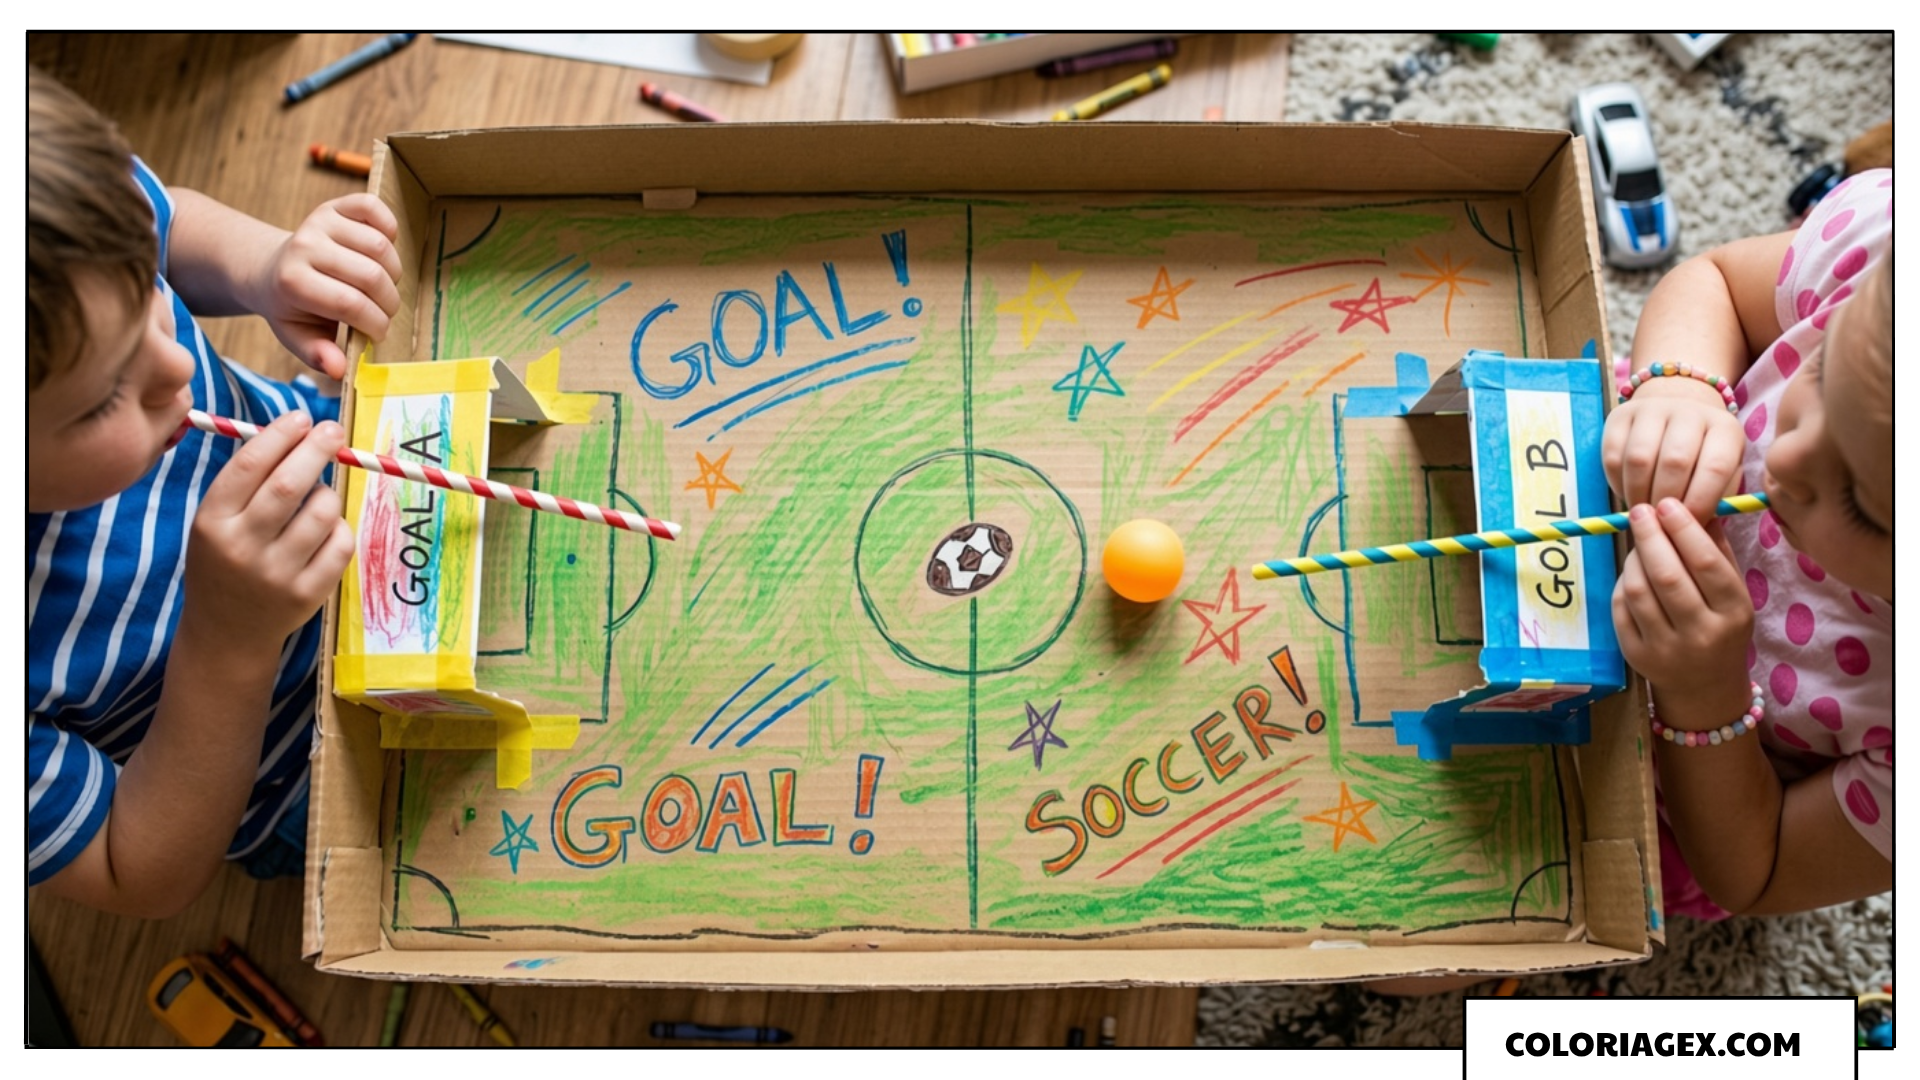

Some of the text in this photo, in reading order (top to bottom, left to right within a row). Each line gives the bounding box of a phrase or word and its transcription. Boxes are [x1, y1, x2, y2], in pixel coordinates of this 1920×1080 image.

[630, 229, 922, 400] GOAL!
[392, 431, 442, 606] GOAL A
[1526, 439, 1574, 608] GOL B
[551, 754, 884, 868] GOAL!
[1025, 645, 1326, 877] SOCCER!
